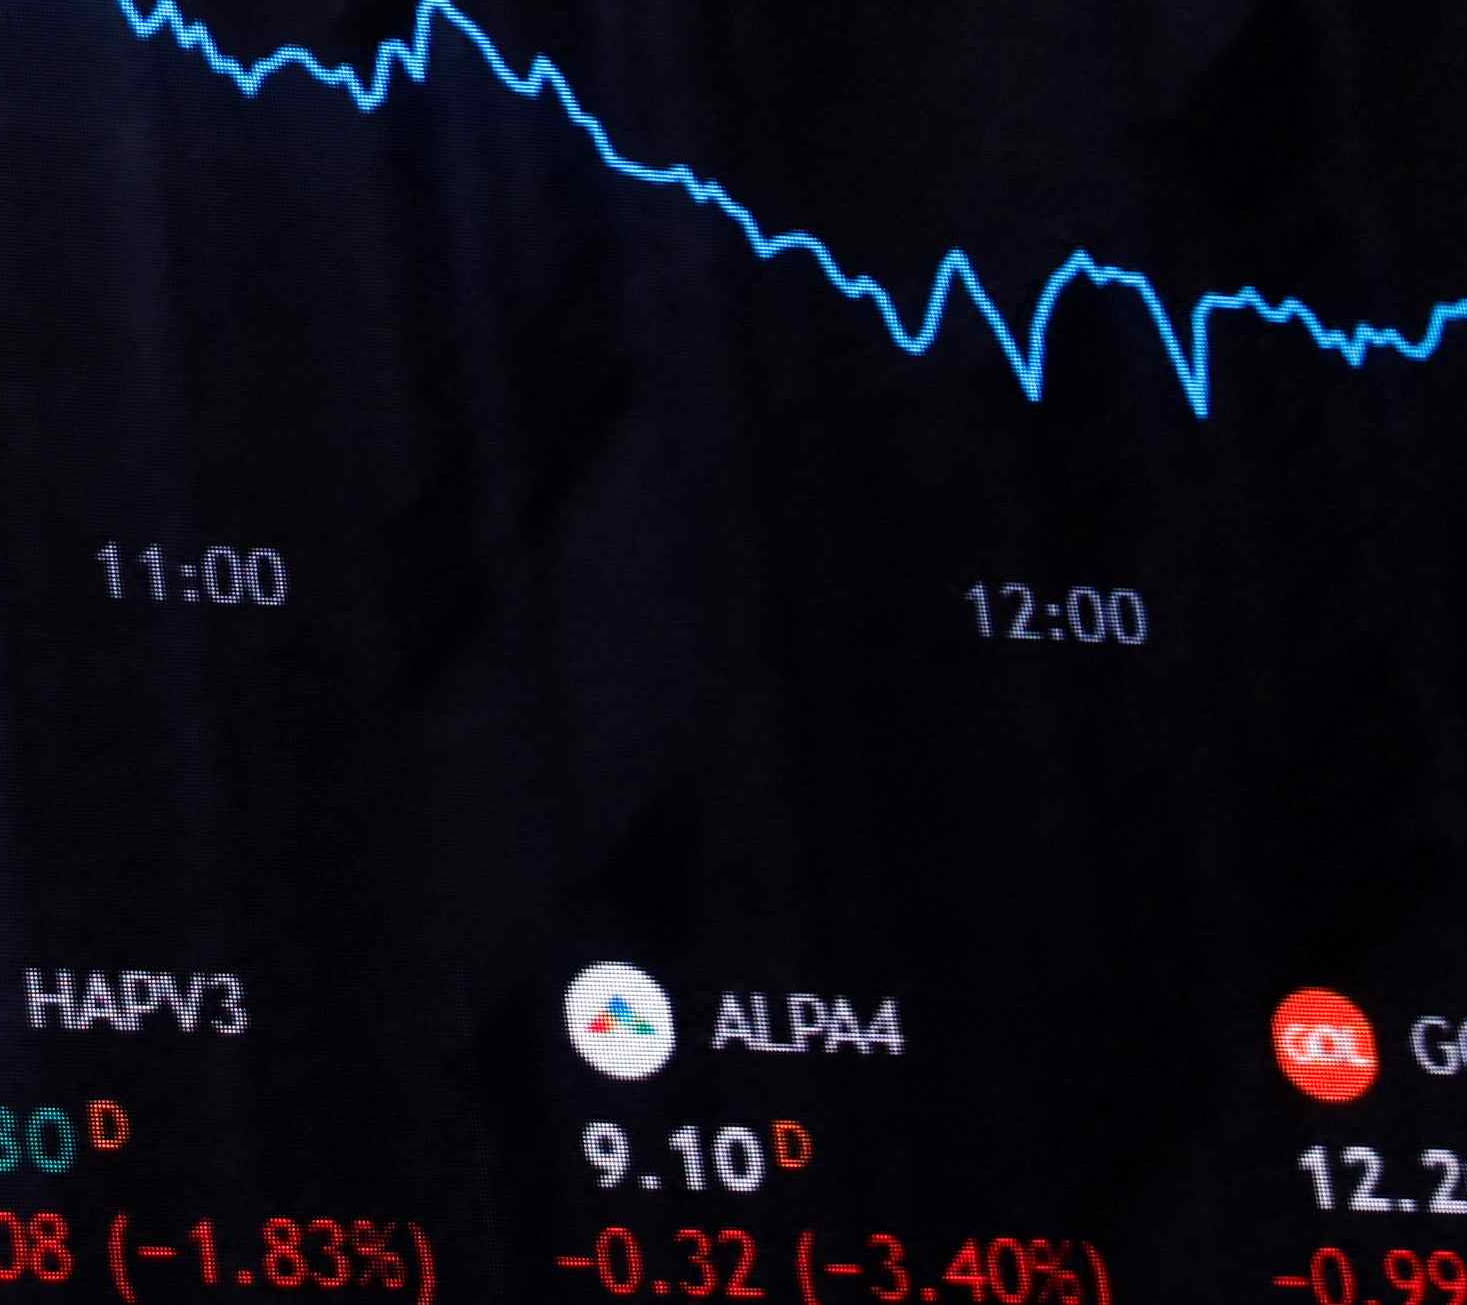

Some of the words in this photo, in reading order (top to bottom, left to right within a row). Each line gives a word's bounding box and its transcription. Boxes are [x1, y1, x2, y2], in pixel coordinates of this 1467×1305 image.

[96, 541, 289, 606] 11:00
[964, 578, 1149, 649] 12:00
[24, 967, 249, 1035] HAPV3
[711, 992, 905, 1056] ALPA4
[85, 1098, 129, 1151] D
[583, 1120, 764, 1193] 9.10
[772, 1118, 813, 1169] D
[109, 1213, 436, 1305] (-1.83%)
[556, 1226, 764, 1296] -0.32
[798, 1229, 1111, 1305] (-3.40%)
